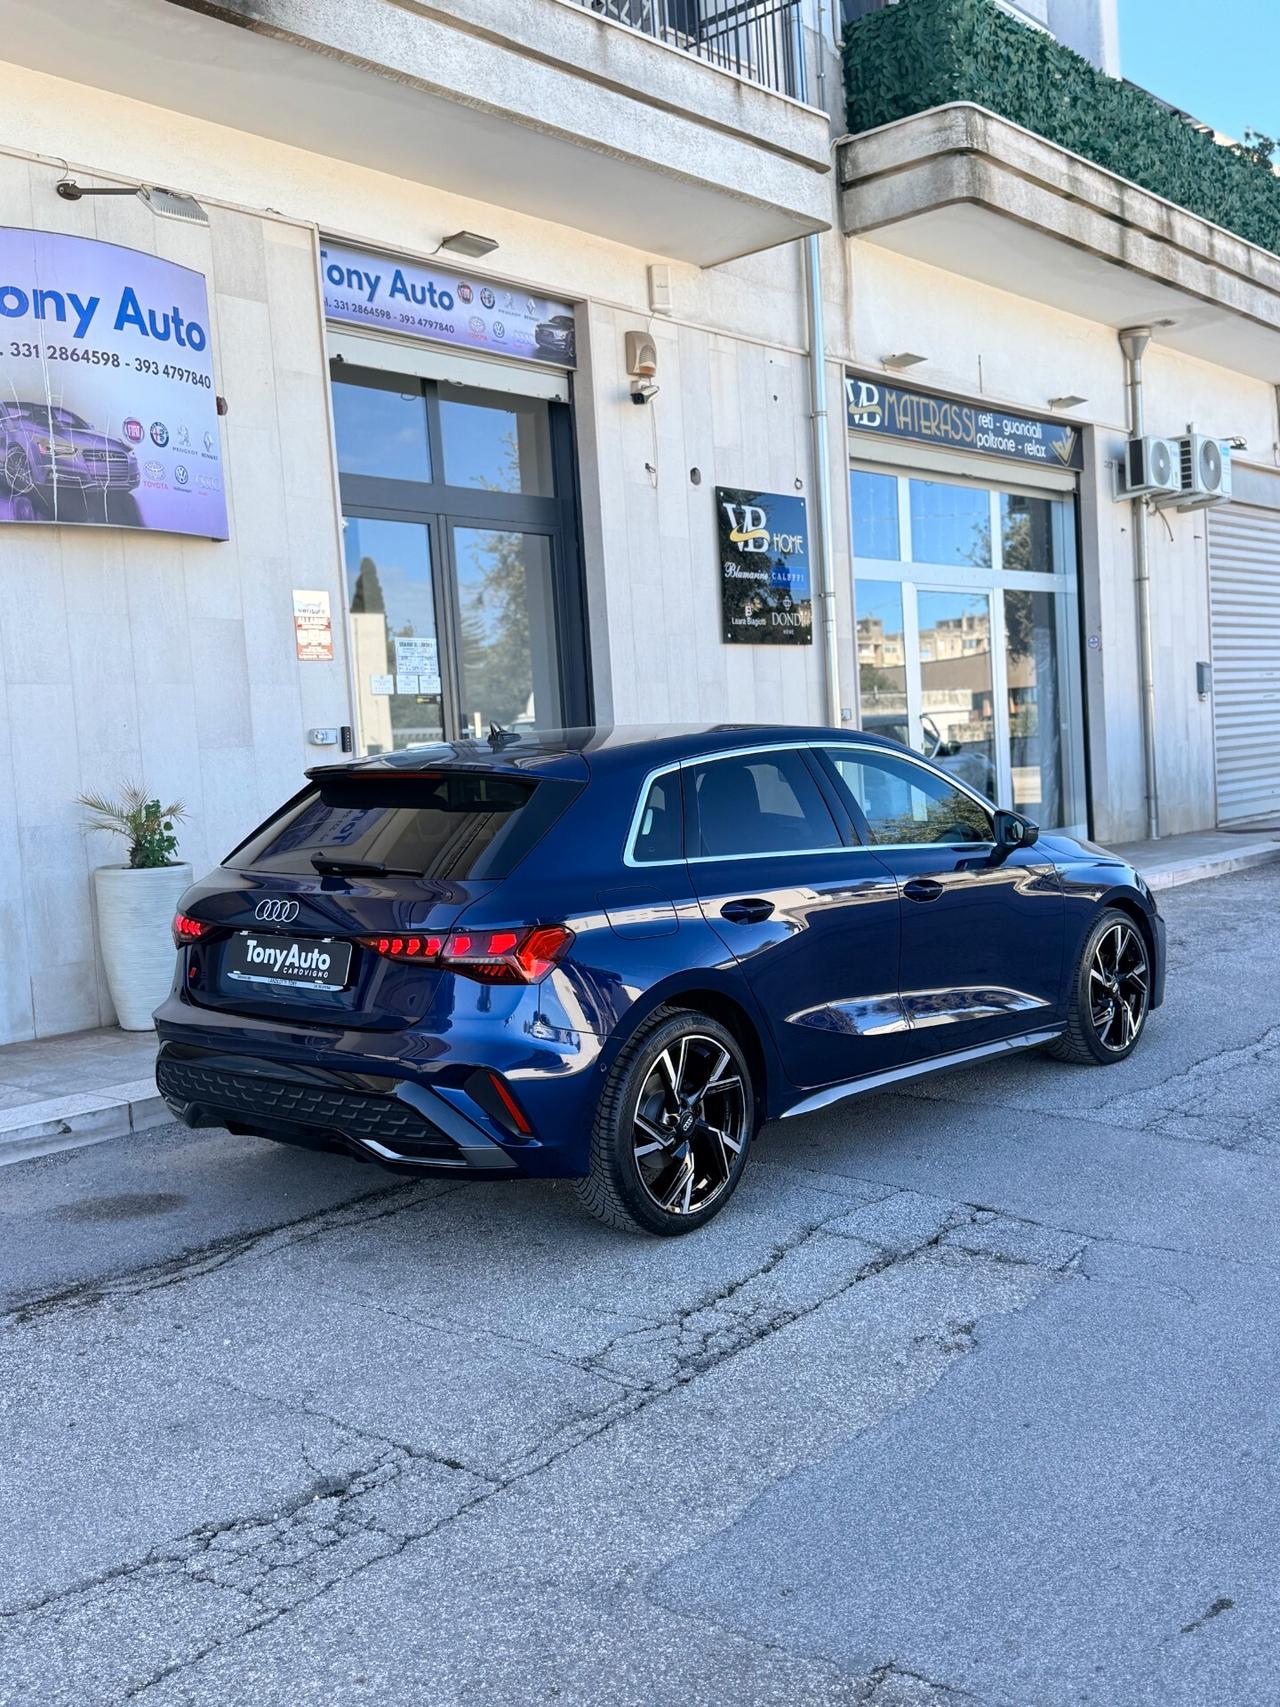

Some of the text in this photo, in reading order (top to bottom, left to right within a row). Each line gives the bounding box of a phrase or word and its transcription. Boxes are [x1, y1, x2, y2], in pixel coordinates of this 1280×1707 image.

[389, 269, 454, 311] Auto
[113, 286, 206, 351] Auto
[334, 299, 350, 311] 331
[352, 303, 391, 320] 2864598
[399, 313, 416, 325] 393
[417, 318, 455, 333] 4797840
[10, 342, 39, 358] 331
[47, 345, 120, 368] 2864598
[135, 357, 159, 376] 393
[162, 364, 212, 389] 4797840
[884, 388, 977, 444] MATERASSI
[978, 413, 994, 429] reti
[1002, 419, 1042, 440] guanciali
[976, 431, 1016, 452] poltrone
[1024, 440, 1047, 458] relax
[143, 480, 168, 490] TOYOTA
[723, 502, 769, 553] VB
[773, 532, 804, 554] HOME
[283, 967, 329, 978] CAROVIGNO
